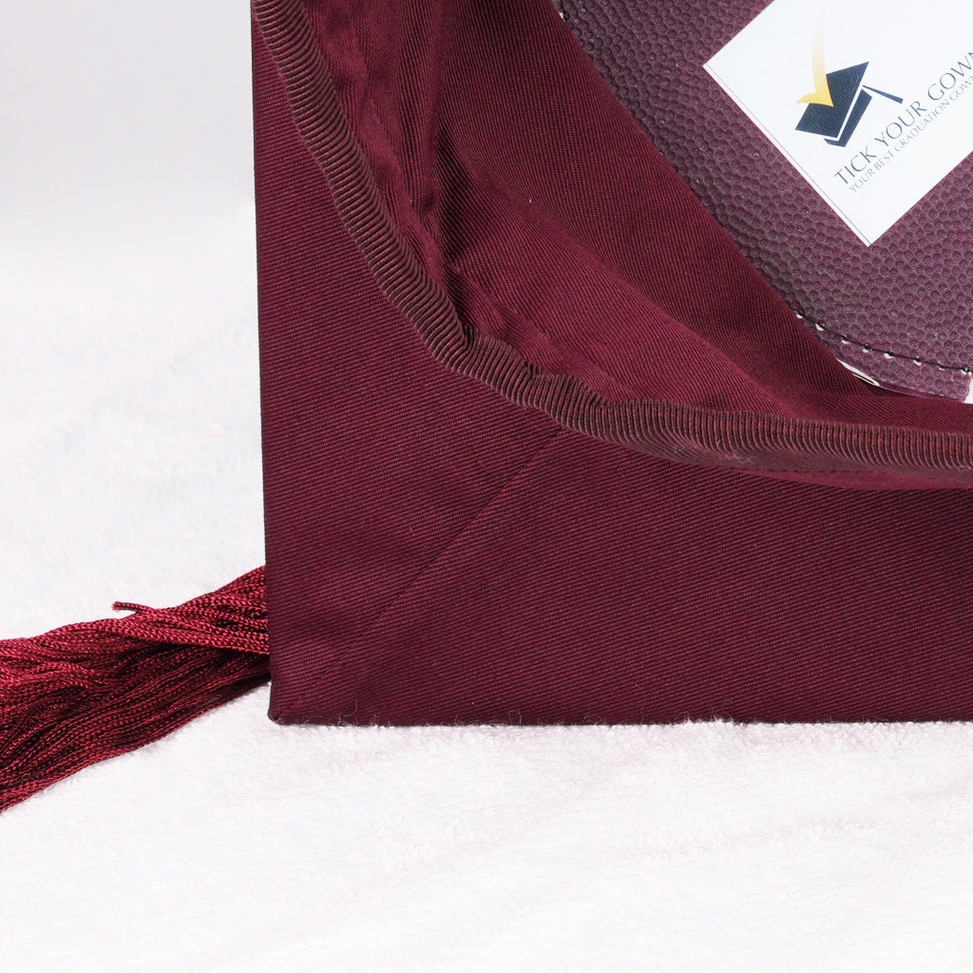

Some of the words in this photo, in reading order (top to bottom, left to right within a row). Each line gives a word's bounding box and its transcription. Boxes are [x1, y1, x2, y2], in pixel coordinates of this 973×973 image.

[833, 146, 877, 185] TICK
[874, 100, 927, 147] YOUR
[848, 167, 877, 193] YOUR
[875, 150, 896, 172] BEST
[895, 101, 950, 152] GRADUATION
